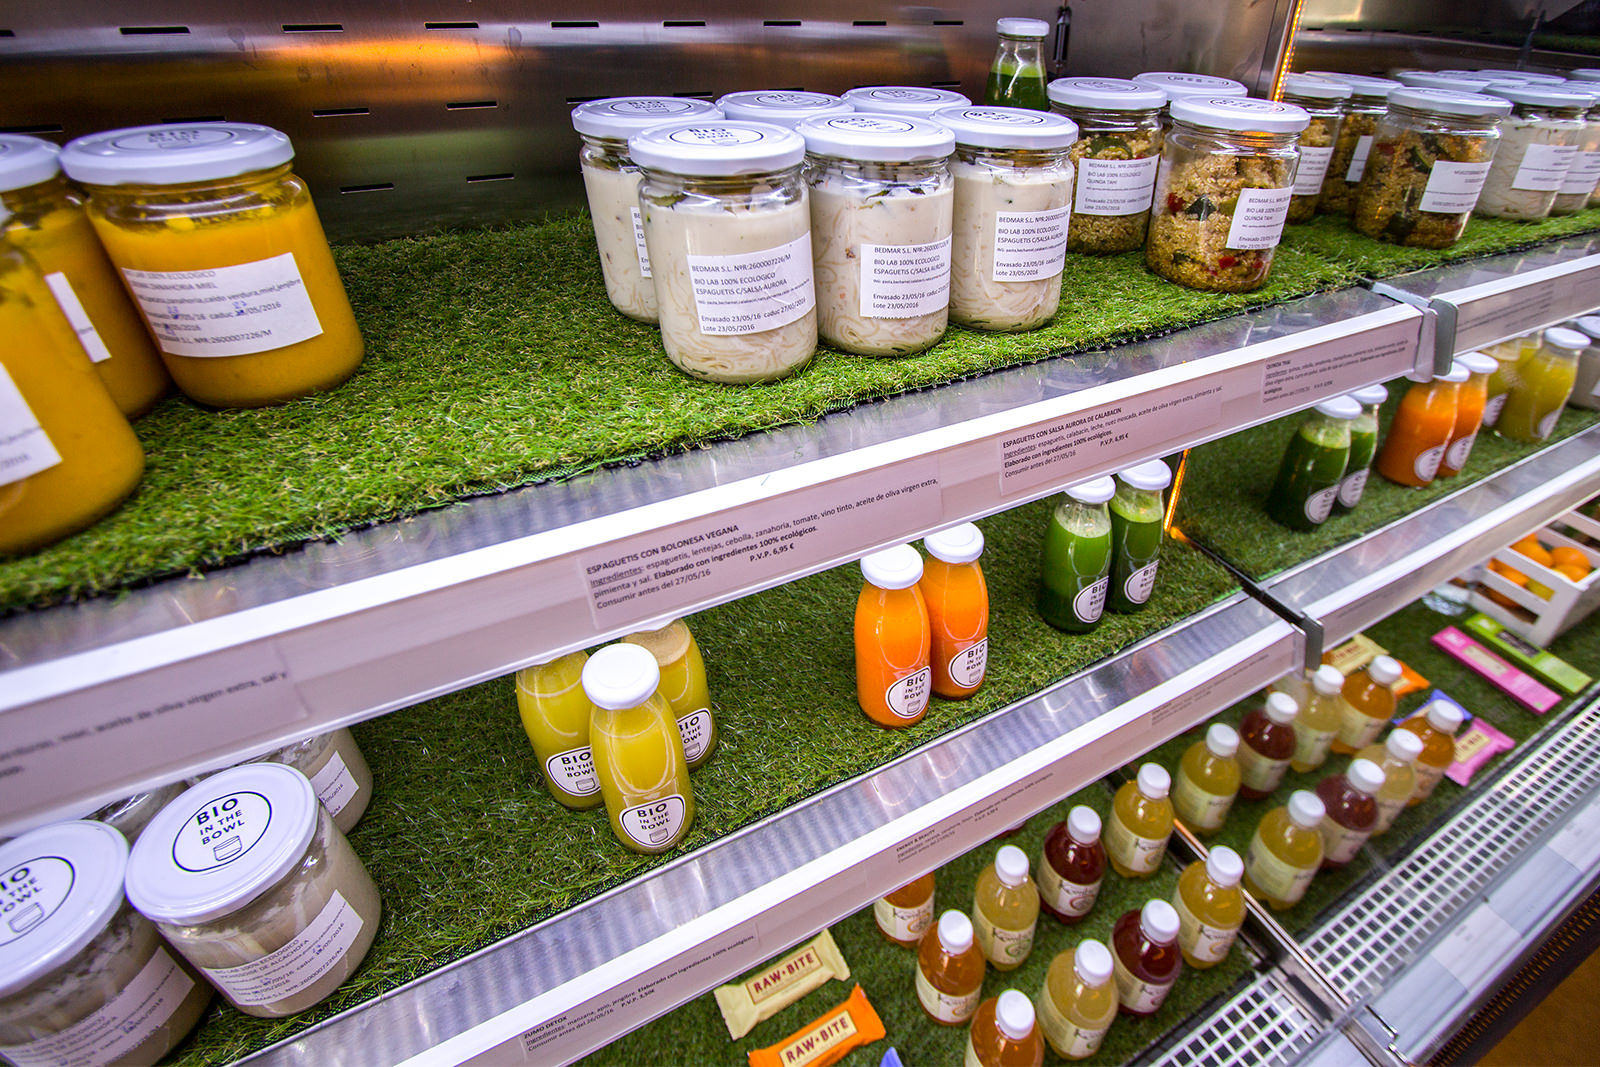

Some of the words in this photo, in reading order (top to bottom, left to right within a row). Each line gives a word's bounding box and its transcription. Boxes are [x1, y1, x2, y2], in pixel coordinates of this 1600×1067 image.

[736, 285, 763, 295] C/SALSA
[763, 279, 788, 290] AURORA
[739, 272, 776, 284] ECOLOGICO
[731, 313, 762, 322] 23/05/16
[763, 309, 780, 318] caduc
[718, 324, 755, 332] 23/05/2016
[1002, 433, 1035, 448] ESPAGUETIS
[1036, 430, 1048, 438] CON
[1048, 425, 1065, 434] SALSA
[1065, 418, 1087, 429] AURORA
[1094, 408, 1122, 421] CALABACIN
[1004, 456, 1031, 468] Elaborado
[1042, 442, 1073, 457] ingredientes
[1073, 437, 1087, 446] 100%
[1004, 465, 1030, 478] Consumir
[1030, 461, 1044, 470] antes
[646, 552, 690, 571] espaguetis,
[692, 541, 724, 558] lentejas,
[725, 532, 754, 546] cebolla,
[755, 520, 792, 537] zanahoria,
[792, 513, 820, 527] tomate,
[821, 508, 836, 518] vino
[836, 502, 855, 514] tinto,
[855, 497, 875, 508] aceite
[876, 492, 884, 502] de
[885, 488, 900, 499] oliva
[901, 483, 920, 496] virgen
[920, 477, 938, 488] extra,
[586, 551, 639, 575] ESPAGUETIS
[640, 547, 660, 560] CON
[661, 534, 704, 553] BOLONESA
[705, 524, 739, 540] VEGANA
[750, 550, 773, 562] P.V.P.
[773, 545, 788, 556] 6,95
[593, 582, 631, 600] pimienta
[632, 580, 638, 588] y
[639, 574, 652, 585] sal.
[654, 562, 694, 580] Elaborado
[696, 558, 710, 567] con
[711, 543, 758, 563] ingredientes
[759, 536, 779, 548] 100%
[597, 592, 636, 609] Consumir
[637, 586, 660, 597] antes
[661, 580, 674, 591] del
[674, 569, 711, 586] 27/05/16
[967, 643, 985, 658] BIO
[906, 672, 926, 687] BIO
[904, 690, 924, 700] BOWL
[678, 716, 700, 732] BIO
[683, 731, 702, 744] OWL
[561, 751, 591, 765] BIO
[577, 761, 593, 770] THE
[196, 797, 239, 826] BIO
[637, 802, 667, 818] BIO
[652, 811, 670, 822] THE
[200, 824, 214, 836] IN
[216, 809, 243, 827] THE
[641, 818, 671, 830] BOWL
[201, 820, 245, 846] BOWL
[0, 867, 31, 891] IO
[8, 877, 38, 897] THE
[0, 886, 44, 915] OWL
[260, 939, 299, 964] ECOLOGICO
[637, 976, 667, 993] Elaborado
[667, 971, 678, 979] con
[678, 955, 712, 973] ingredientes
[524, 1026, 545, 1039] ZUMO
[545, 1016, 567, 1029] DETOX
[528, 1034, 557, 1051] Consumir
[559, 1026, 575, 1038] antes
